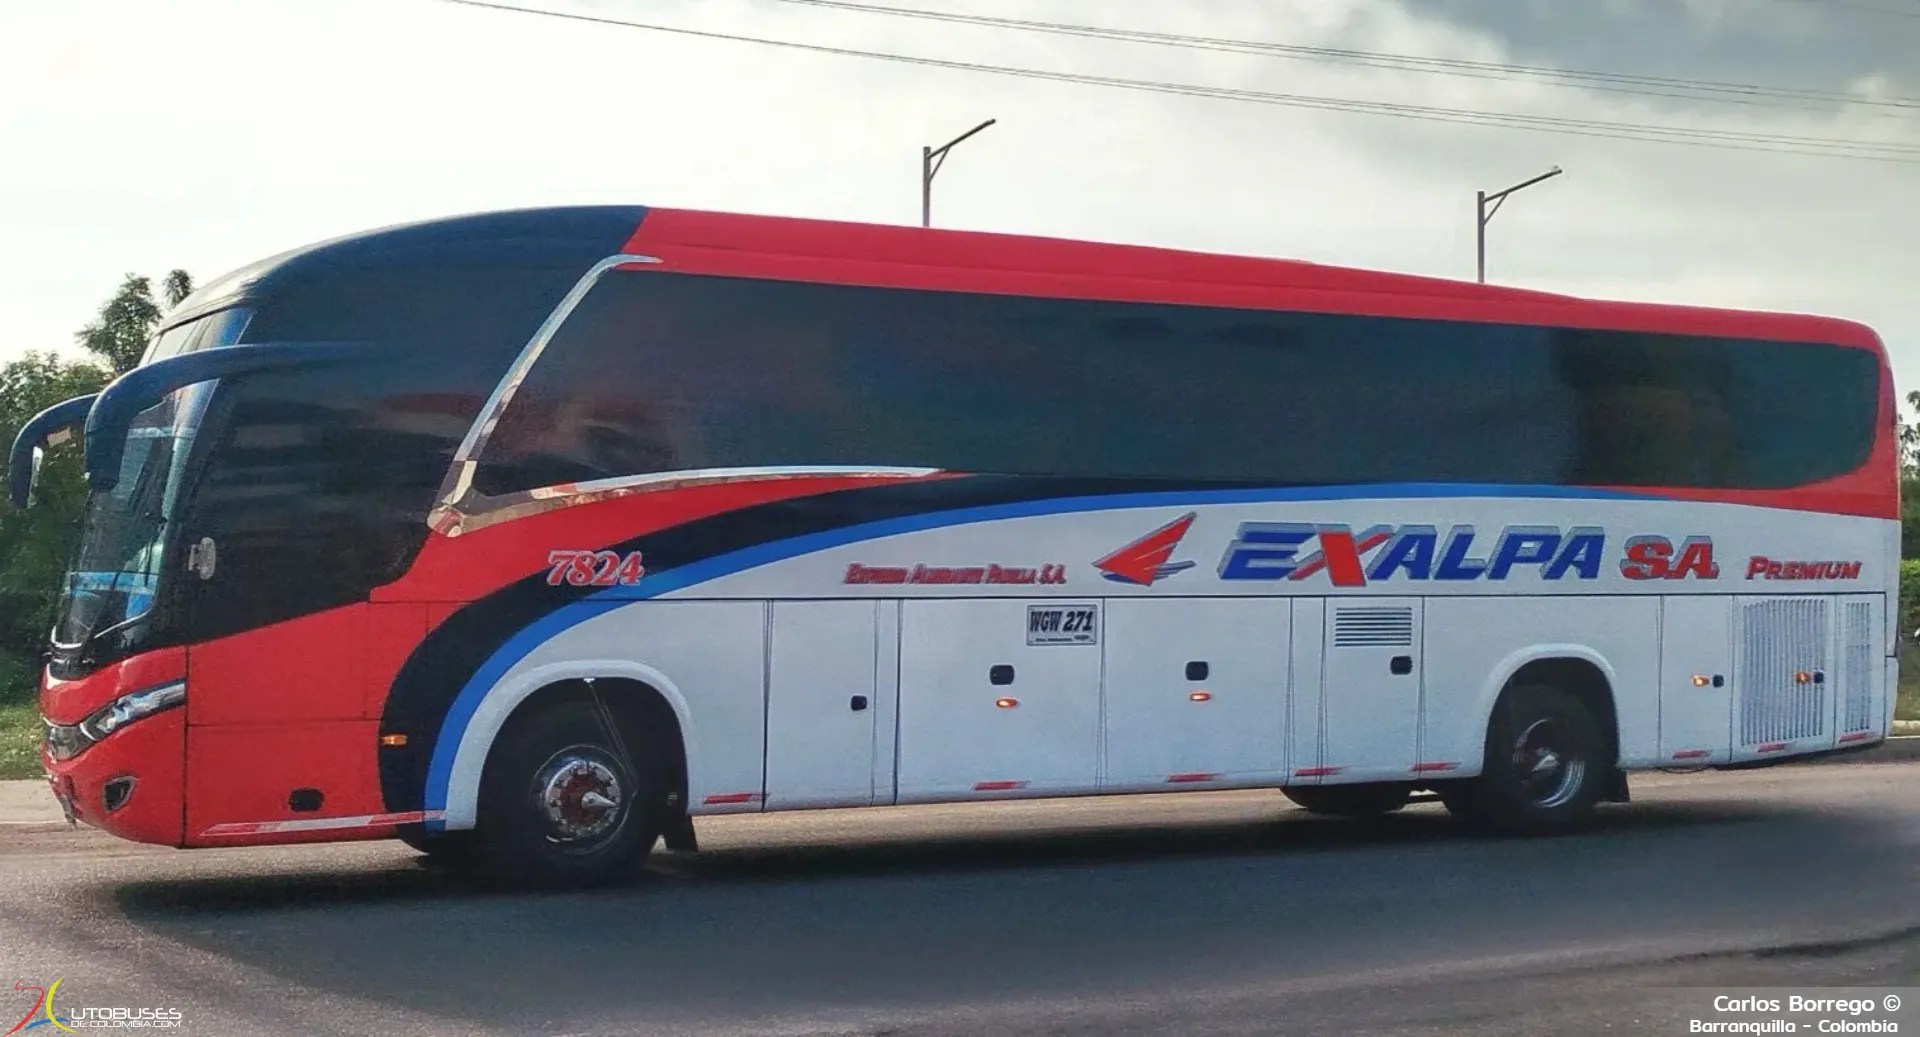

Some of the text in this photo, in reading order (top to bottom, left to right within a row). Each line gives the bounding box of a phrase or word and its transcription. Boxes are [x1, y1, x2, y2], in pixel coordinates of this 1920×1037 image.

[546, 550, 645, 586] 7824
[1216, 521, 1604, 587] EXALPA
[1029, 610, 1093, 633] WGW 271
